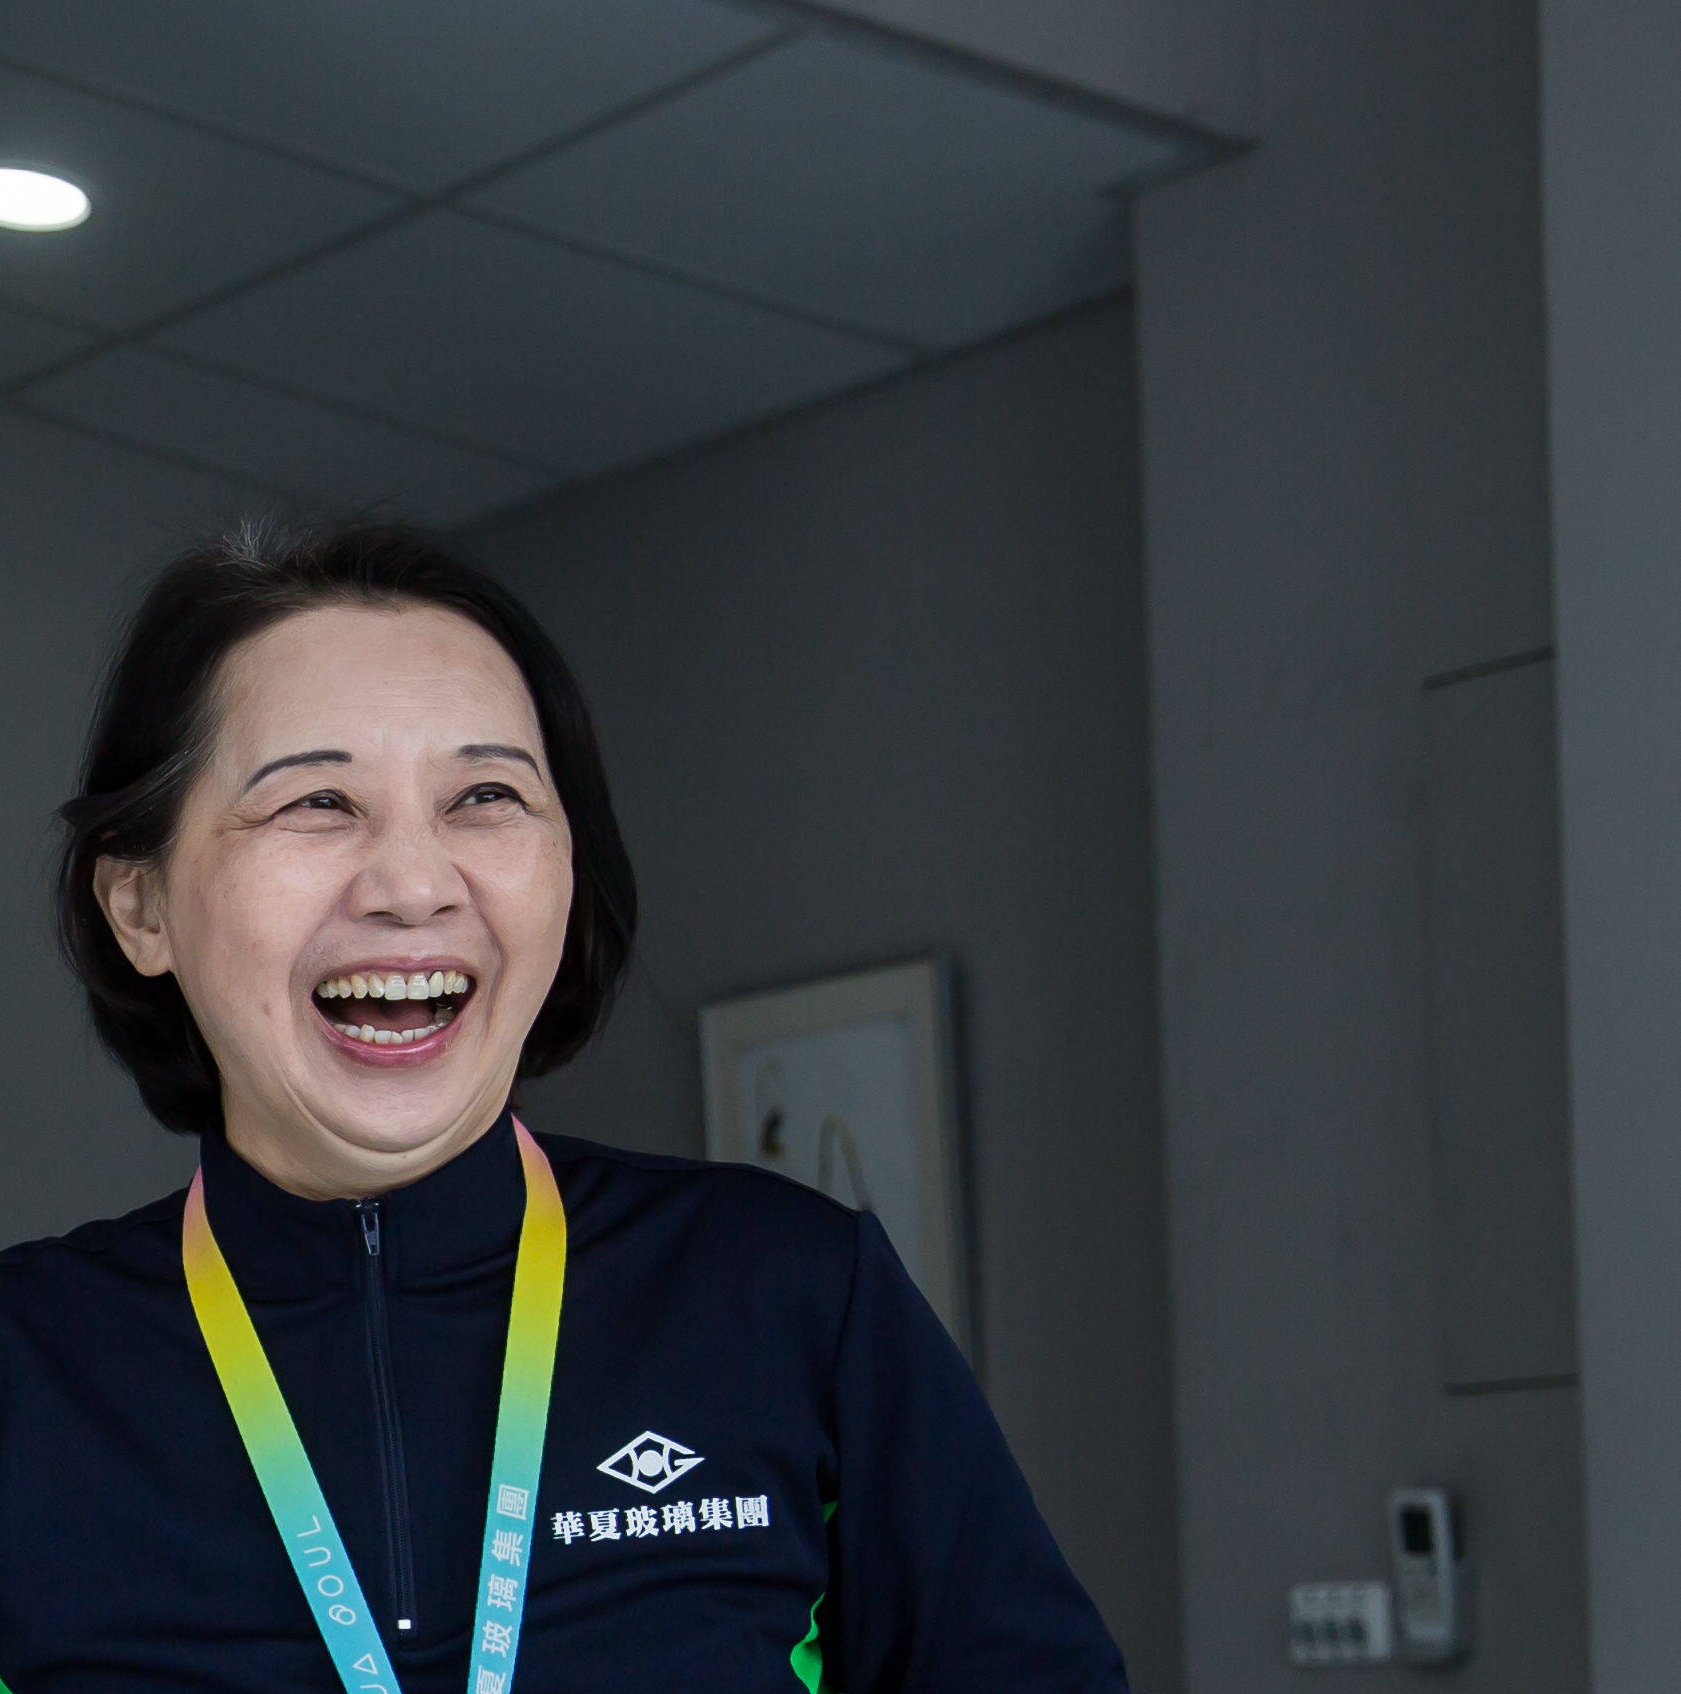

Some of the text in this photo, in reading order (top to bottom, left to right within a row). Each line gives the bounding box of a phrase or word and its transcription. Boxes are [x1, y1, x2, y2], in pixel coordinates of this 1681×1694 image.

[550, 1494, 770, 1545] 華夏玻璃集團
